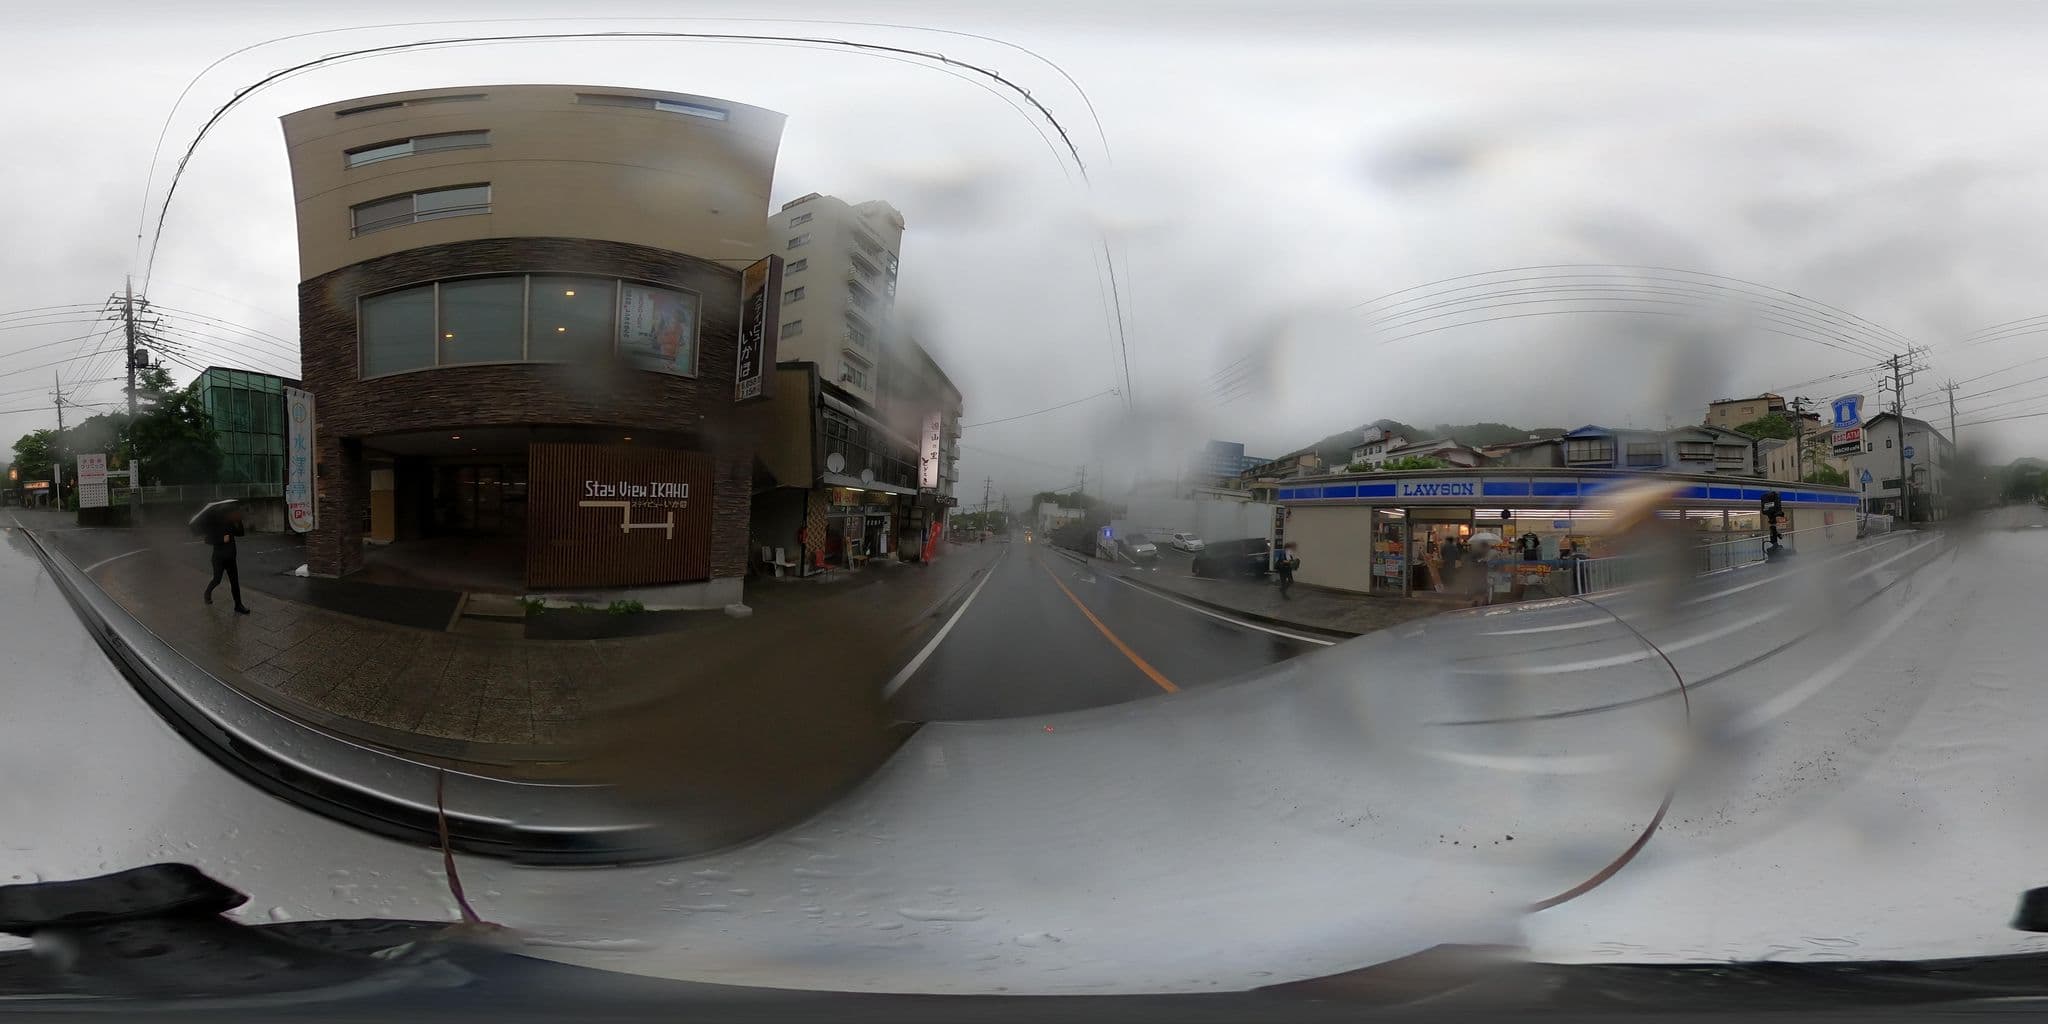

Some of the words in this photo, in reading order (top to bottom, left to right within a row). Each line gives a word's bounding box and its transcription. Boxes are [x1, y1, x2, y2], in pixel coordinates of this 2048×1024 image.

[740, 330, 753, 378] いかほ
[584, 480, 615, 497] Stay
[619, 480, 647, 497] View
[650, 482, 689, 498] IKAHO
[1403, 483, 1474, 496] LAWSON
